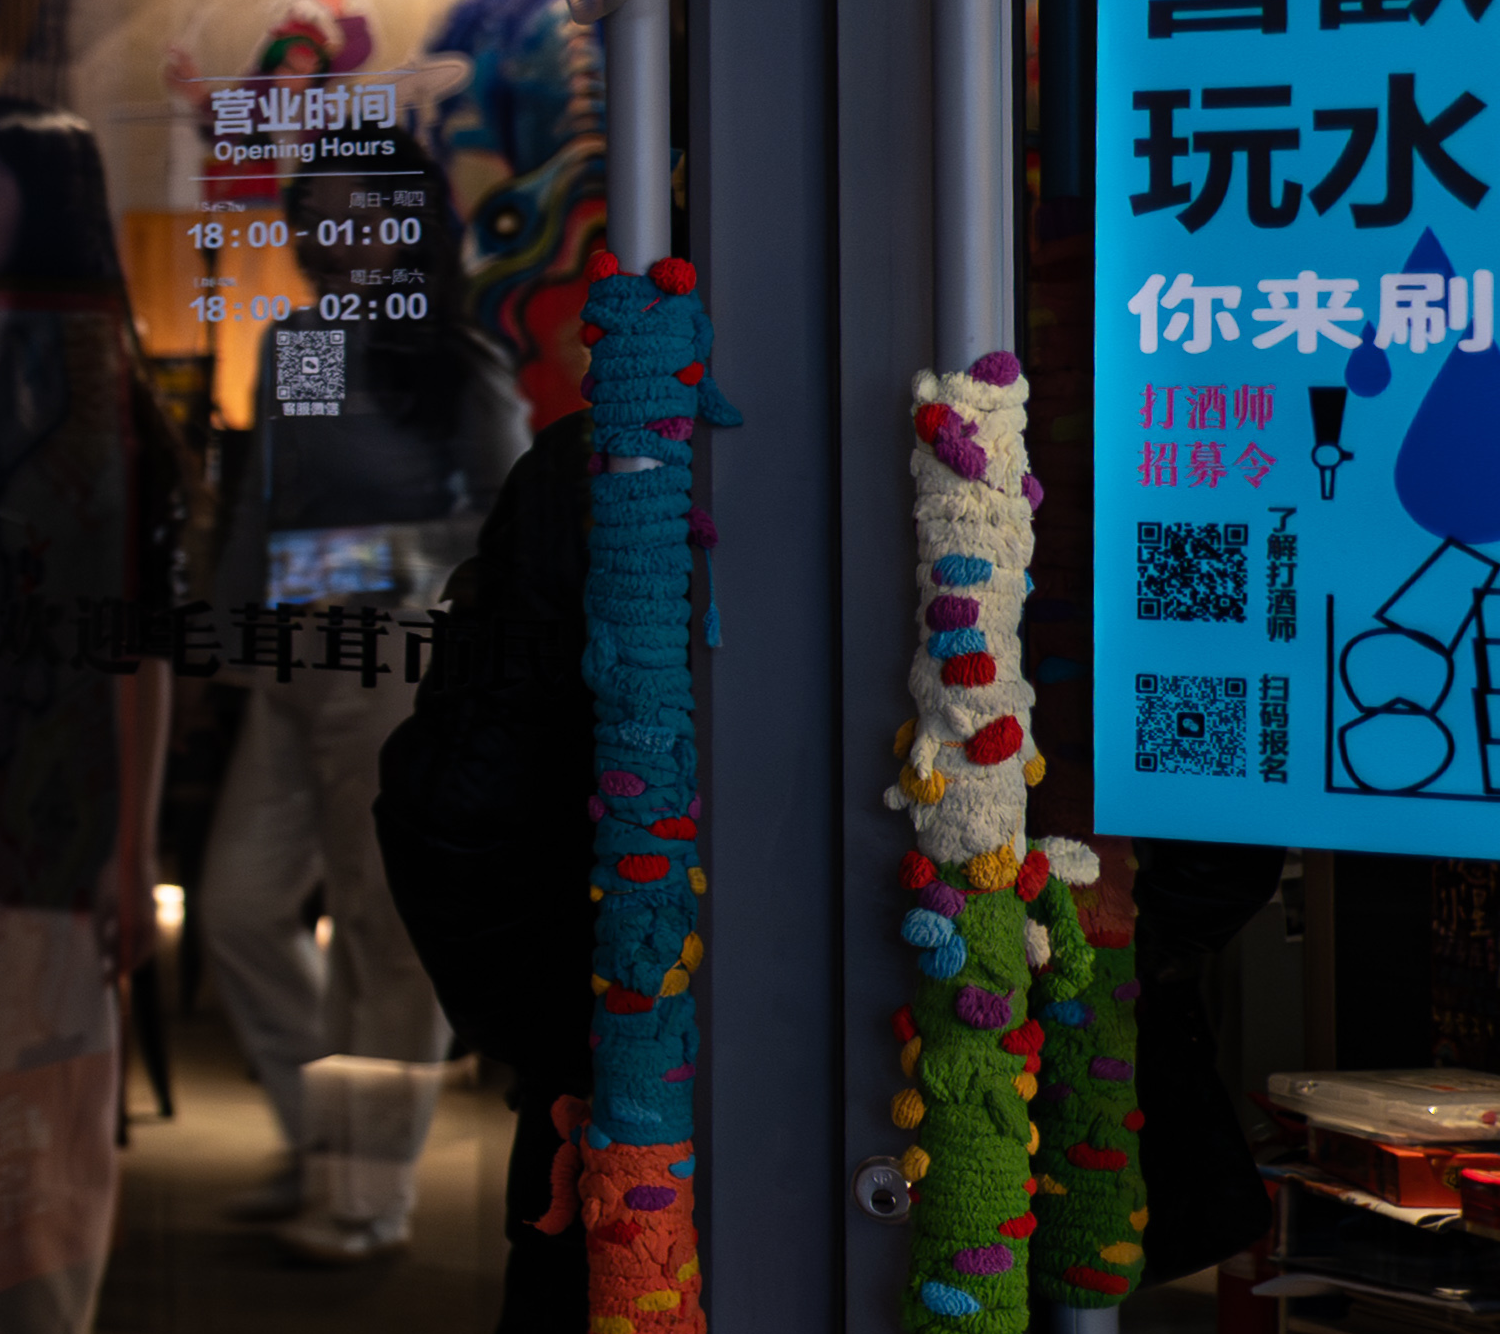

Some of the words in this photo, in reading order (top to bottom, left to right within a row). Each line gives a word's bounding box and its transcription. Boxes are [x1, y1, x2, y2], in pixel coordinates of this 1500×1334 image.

[210, 83, 398, 136] 营业时间
[213, 139, 317, 165] Opening
[320, 137, 396, 157] Hours
[1128, 72, 1491, 235] 玩水
[1127, 267, 1494, 355] 你来刷
[1137, 382, 1276, 433] 打酒师
[1137, 439, 1279, 490] 招募令
[1265, 505, 1298, 644] 了解打酒师
[1257, 672, 1291, 785] 扫码报名
